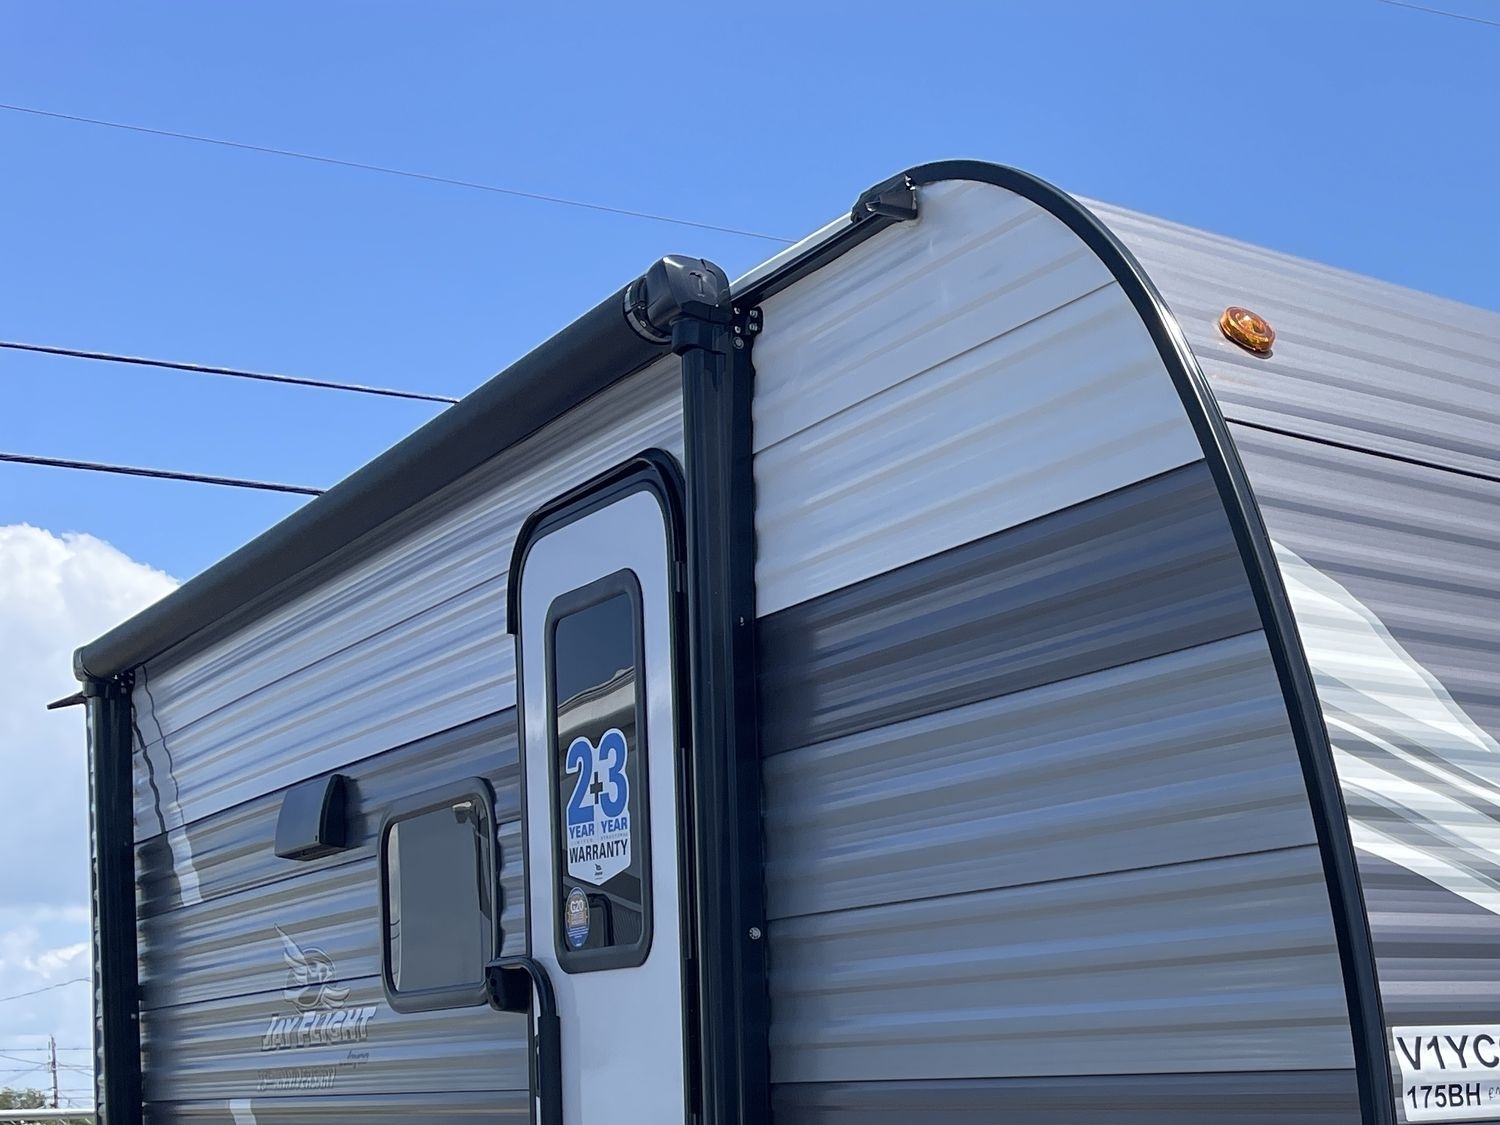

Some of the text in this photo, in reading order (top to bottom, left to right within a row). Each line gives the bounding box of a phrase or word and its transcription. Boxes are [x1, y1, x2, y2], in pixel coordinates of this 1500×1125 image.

[569, 817, 627, 839] YEAR YEAR
[569, 839, 628, 863] WARRANTY
[298, 1007, 376, 1046] FLIGHT
[1407, 1083, 1481, 1109] 175BH
